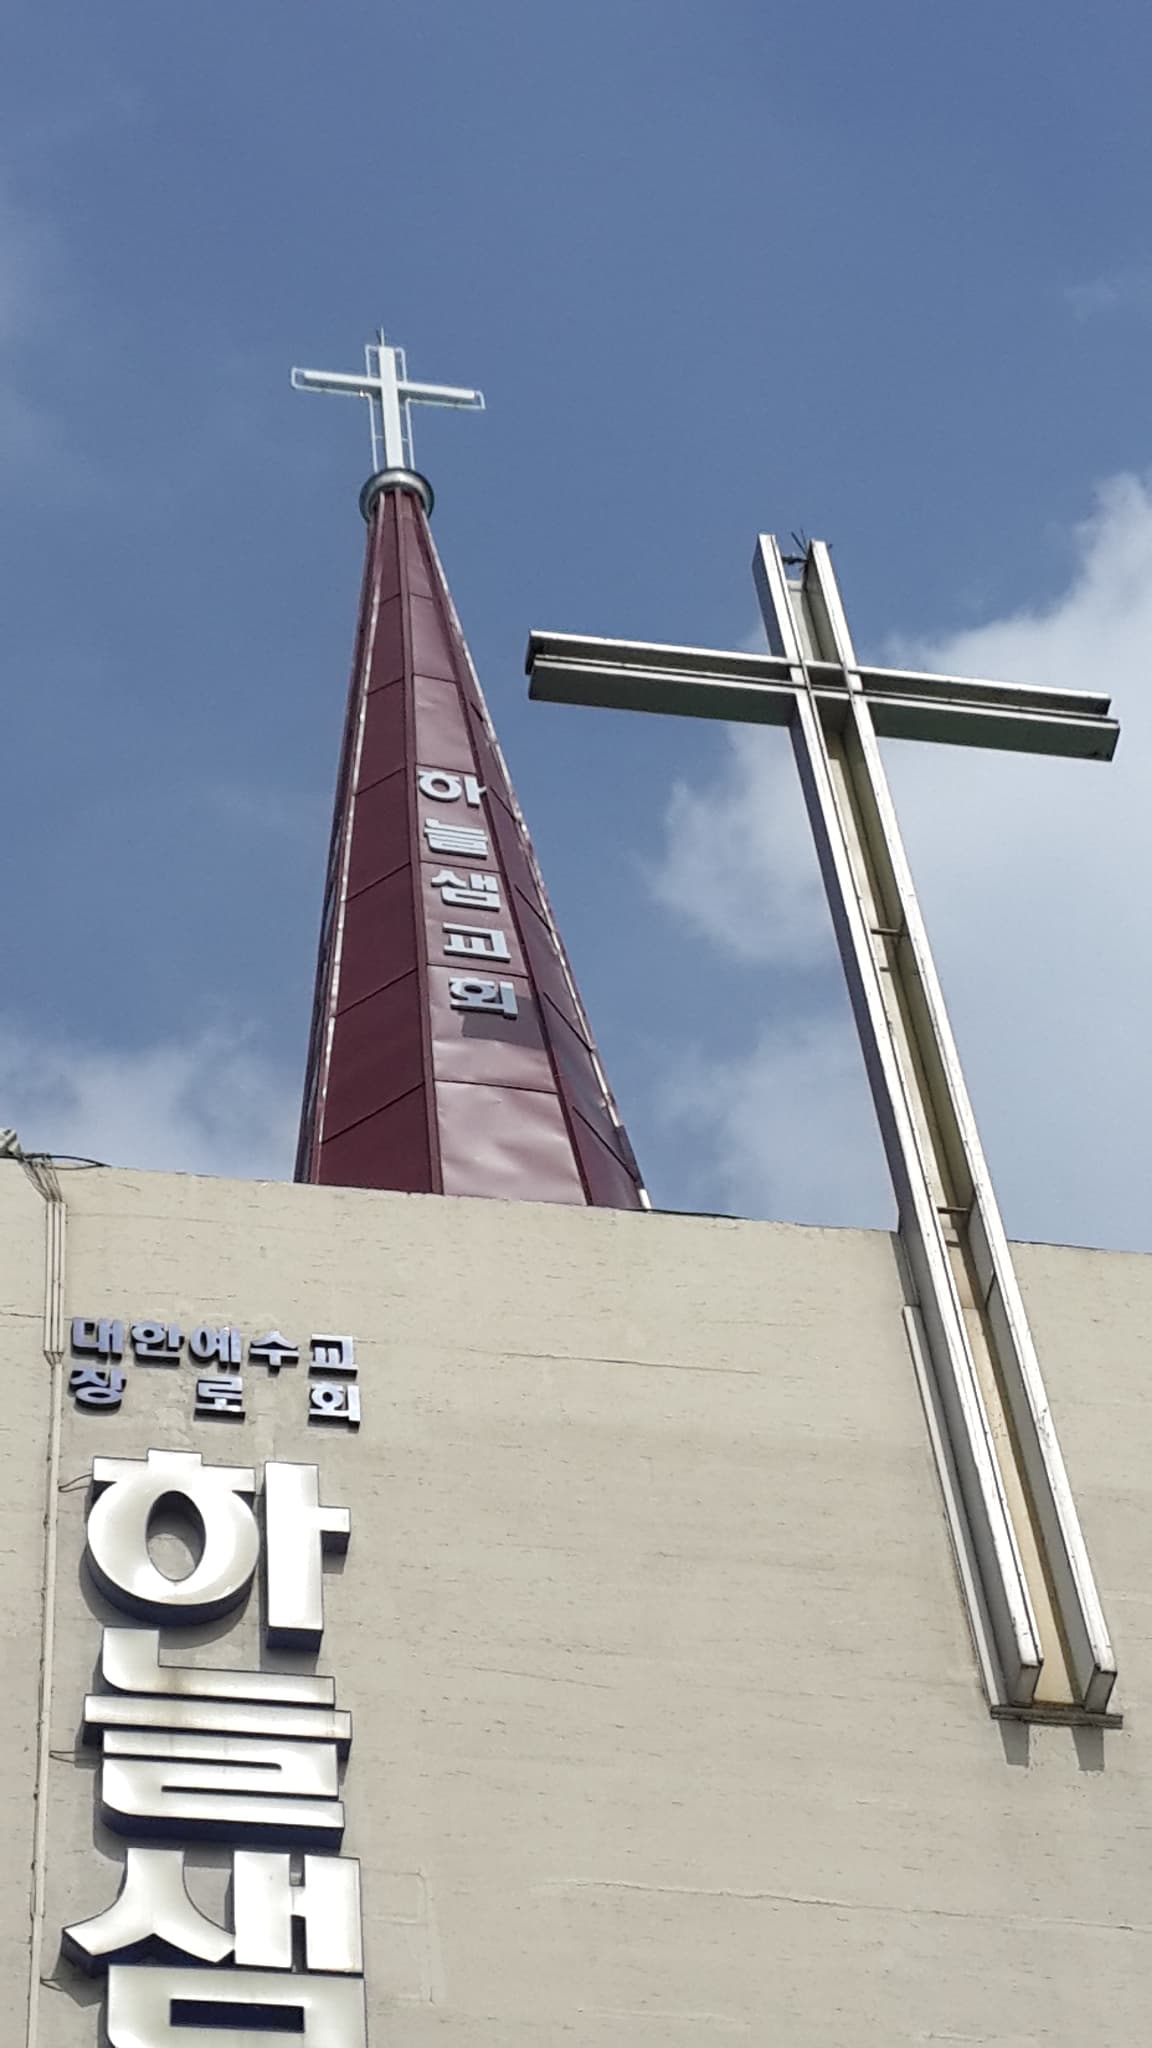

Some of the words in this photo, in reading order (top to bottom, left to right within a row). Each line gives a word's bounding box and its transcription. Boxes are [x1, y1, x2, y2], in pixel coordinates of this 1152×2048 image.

[417, 771, 518, 1020] 하늘샘교회
[71, 1317, 358, 1377] 대한예수교
[62, 1448, 368, 2048] 하늘샘
